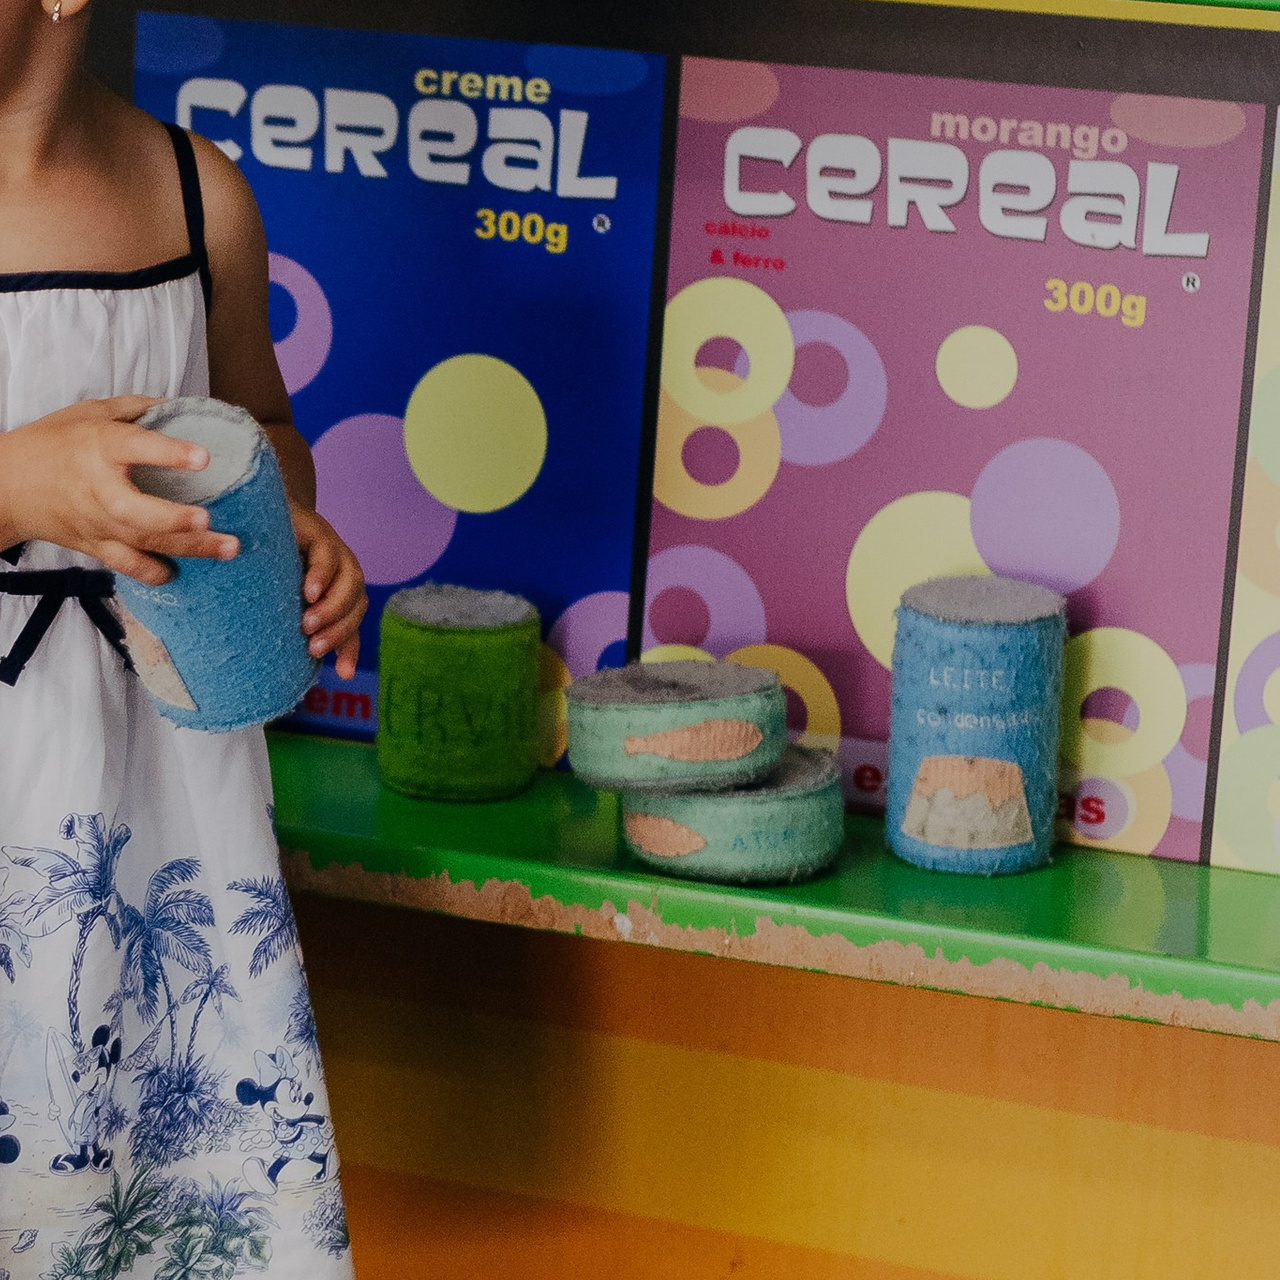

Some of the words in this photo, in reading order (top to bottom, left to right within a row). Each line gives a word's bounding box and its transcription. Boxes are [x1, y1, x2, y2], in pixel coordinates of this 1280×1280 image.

[414, 68, 551, 104] creme
[930, 111, 1128, 160] morango
[475, 209, 568, 254] 300g
[1043, 278, 1148, 328] 300g
